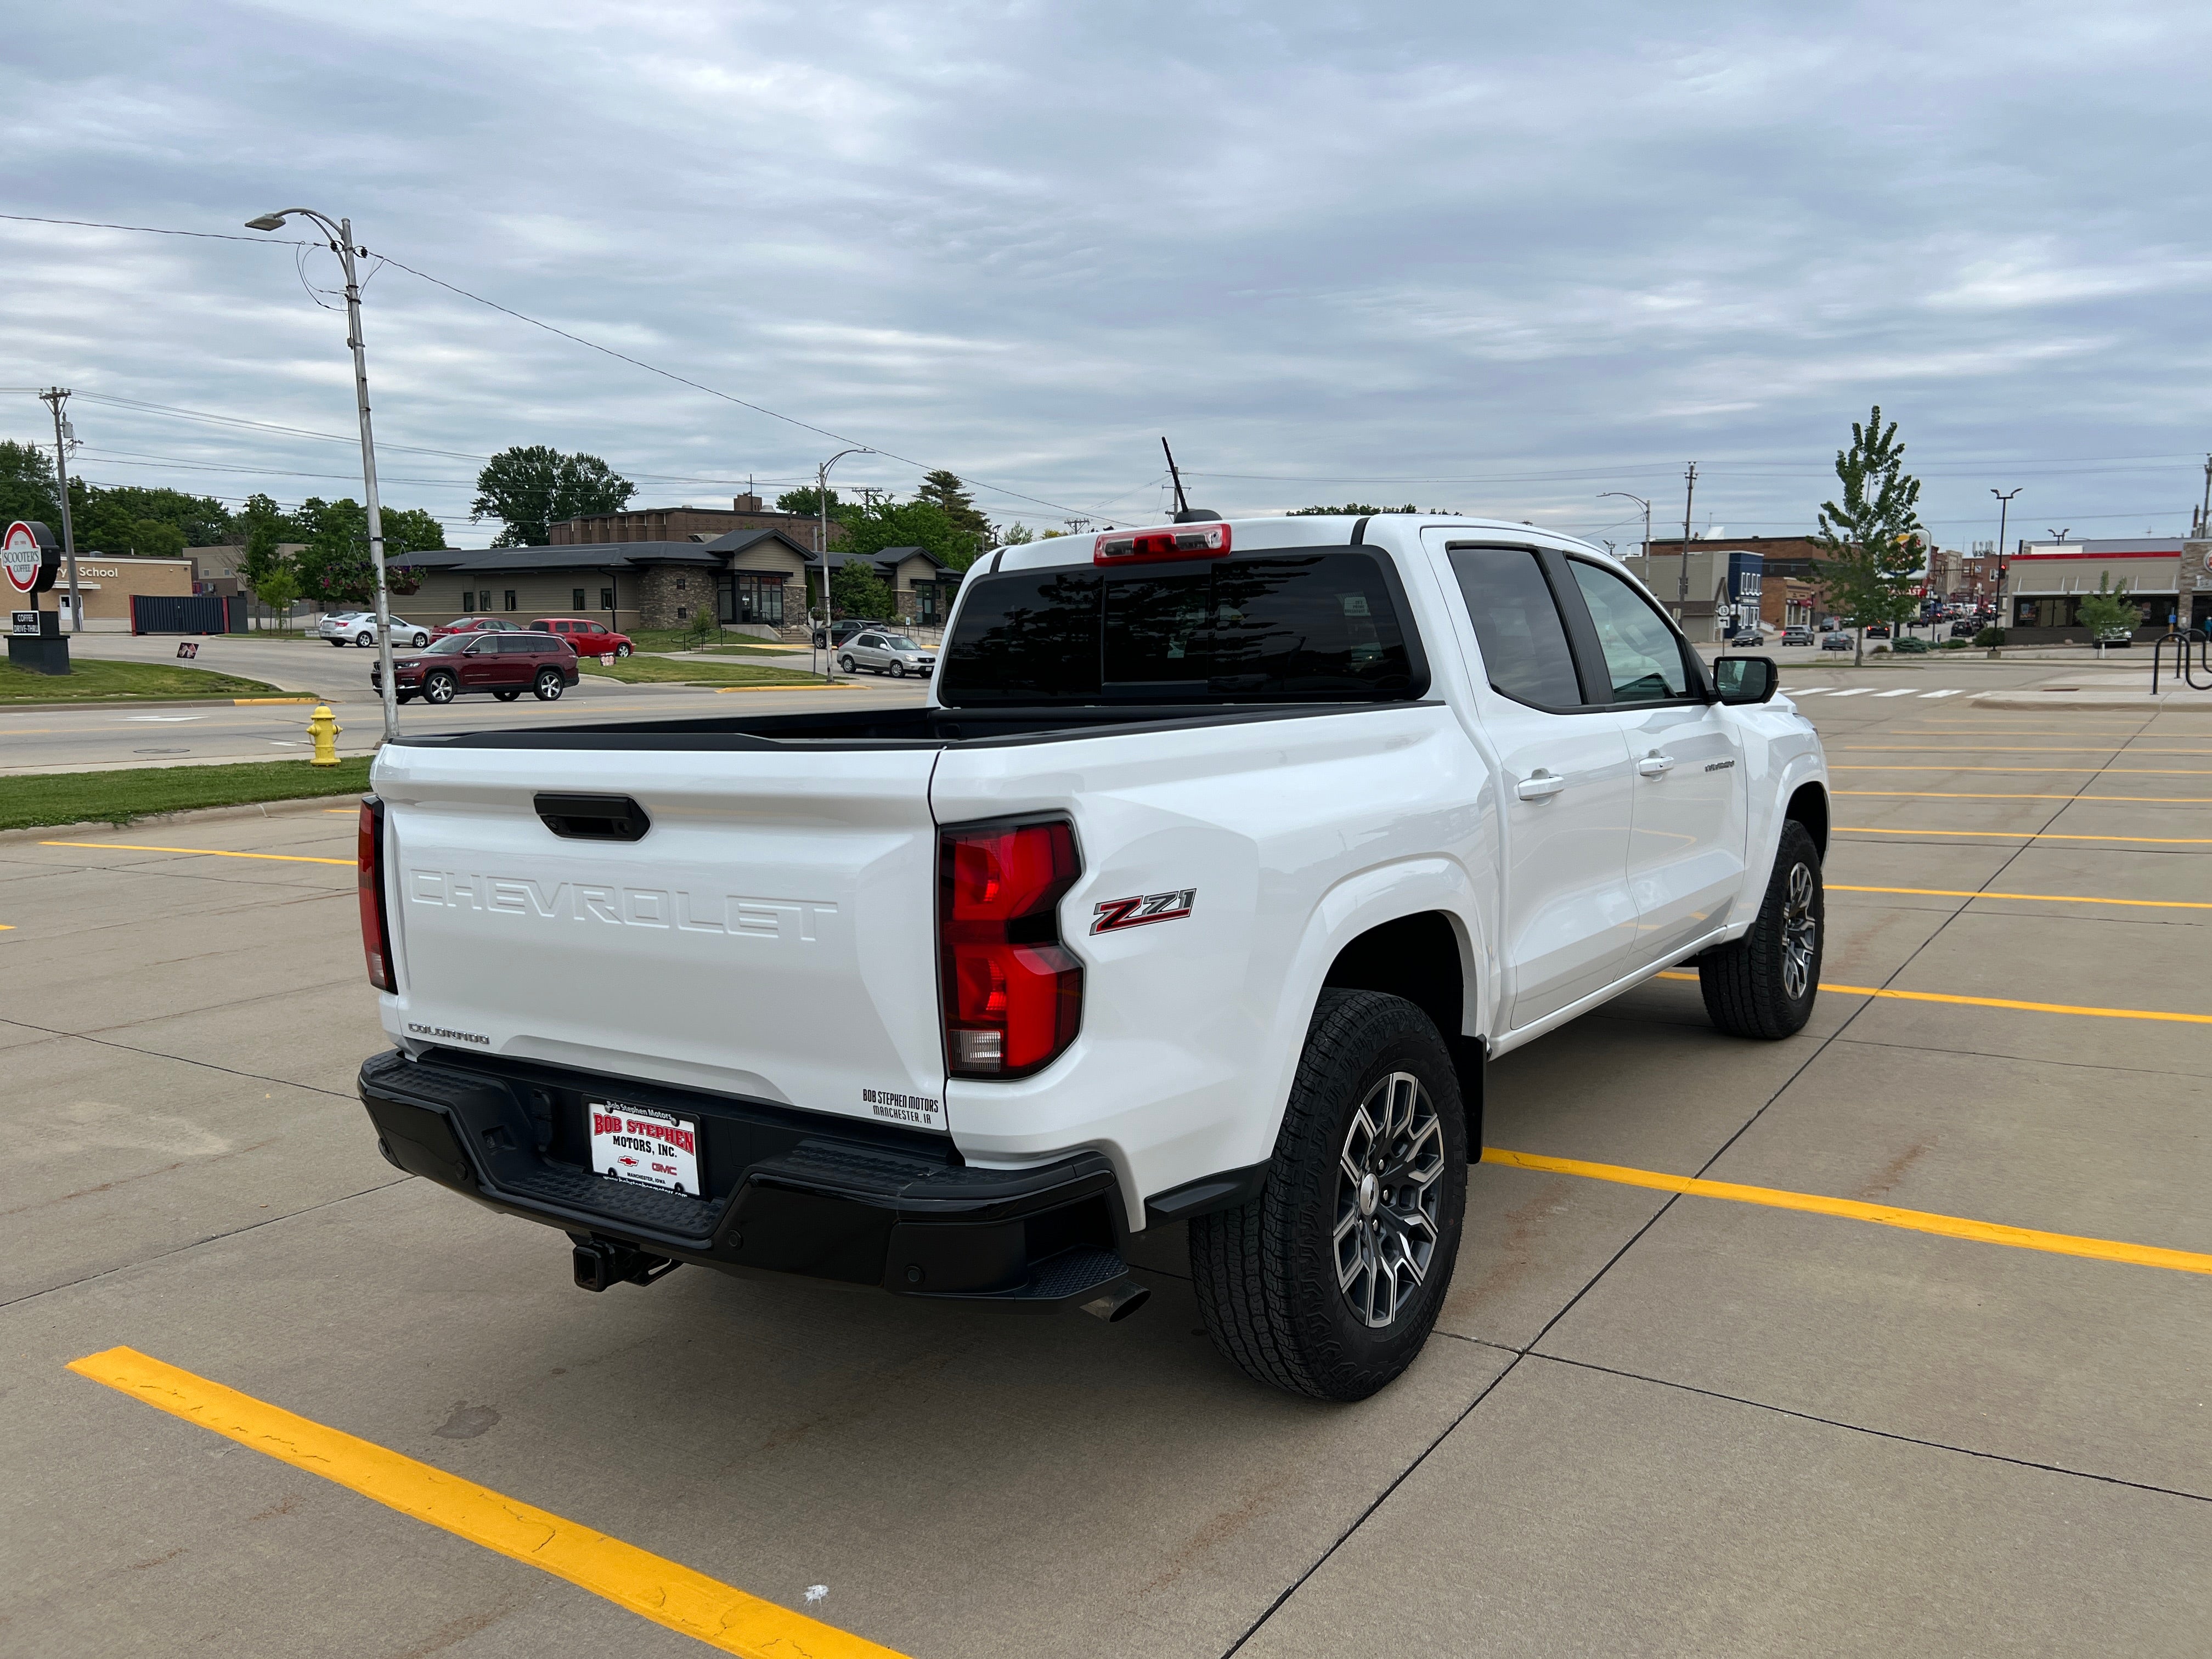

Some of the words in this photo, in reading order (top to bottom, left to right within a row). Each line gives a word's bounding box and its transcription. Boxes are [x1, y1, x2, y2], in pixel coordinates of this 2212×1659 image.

[4, 551, 39, 563] SCOOTER'S
[13, 564, 31, 572] COFFEE
[79, 567, 118, 577] School
[17, 614, 33, 622] COFFEE
[410, 868, 838, 942] CHEVROLET
[1089, 888, 1197, 936] Z71
[408, 1022, 490, 1045] COLORADO
[863, 1088, 876, 1103] BOB
[878, 1091, 907, 1108] STEPHEN
[909, 1096, 939, 1113] MOTORS
[606, 1101, 620, 1110] Bob
[621, 1104, 648, 1117] Stephen
[648, 1109, 672, 1120] Motors
[923, 1113, 932, 1124] IA
[593, 1113, 622, 1136] BOB
[627, 1119, 695, 1156] STEPHEN
[613, 1135, 654, 1155] MOTORS,
[658, 1143, 677, 1158] INC.
[651, 1162, 678, 1176] GMC
